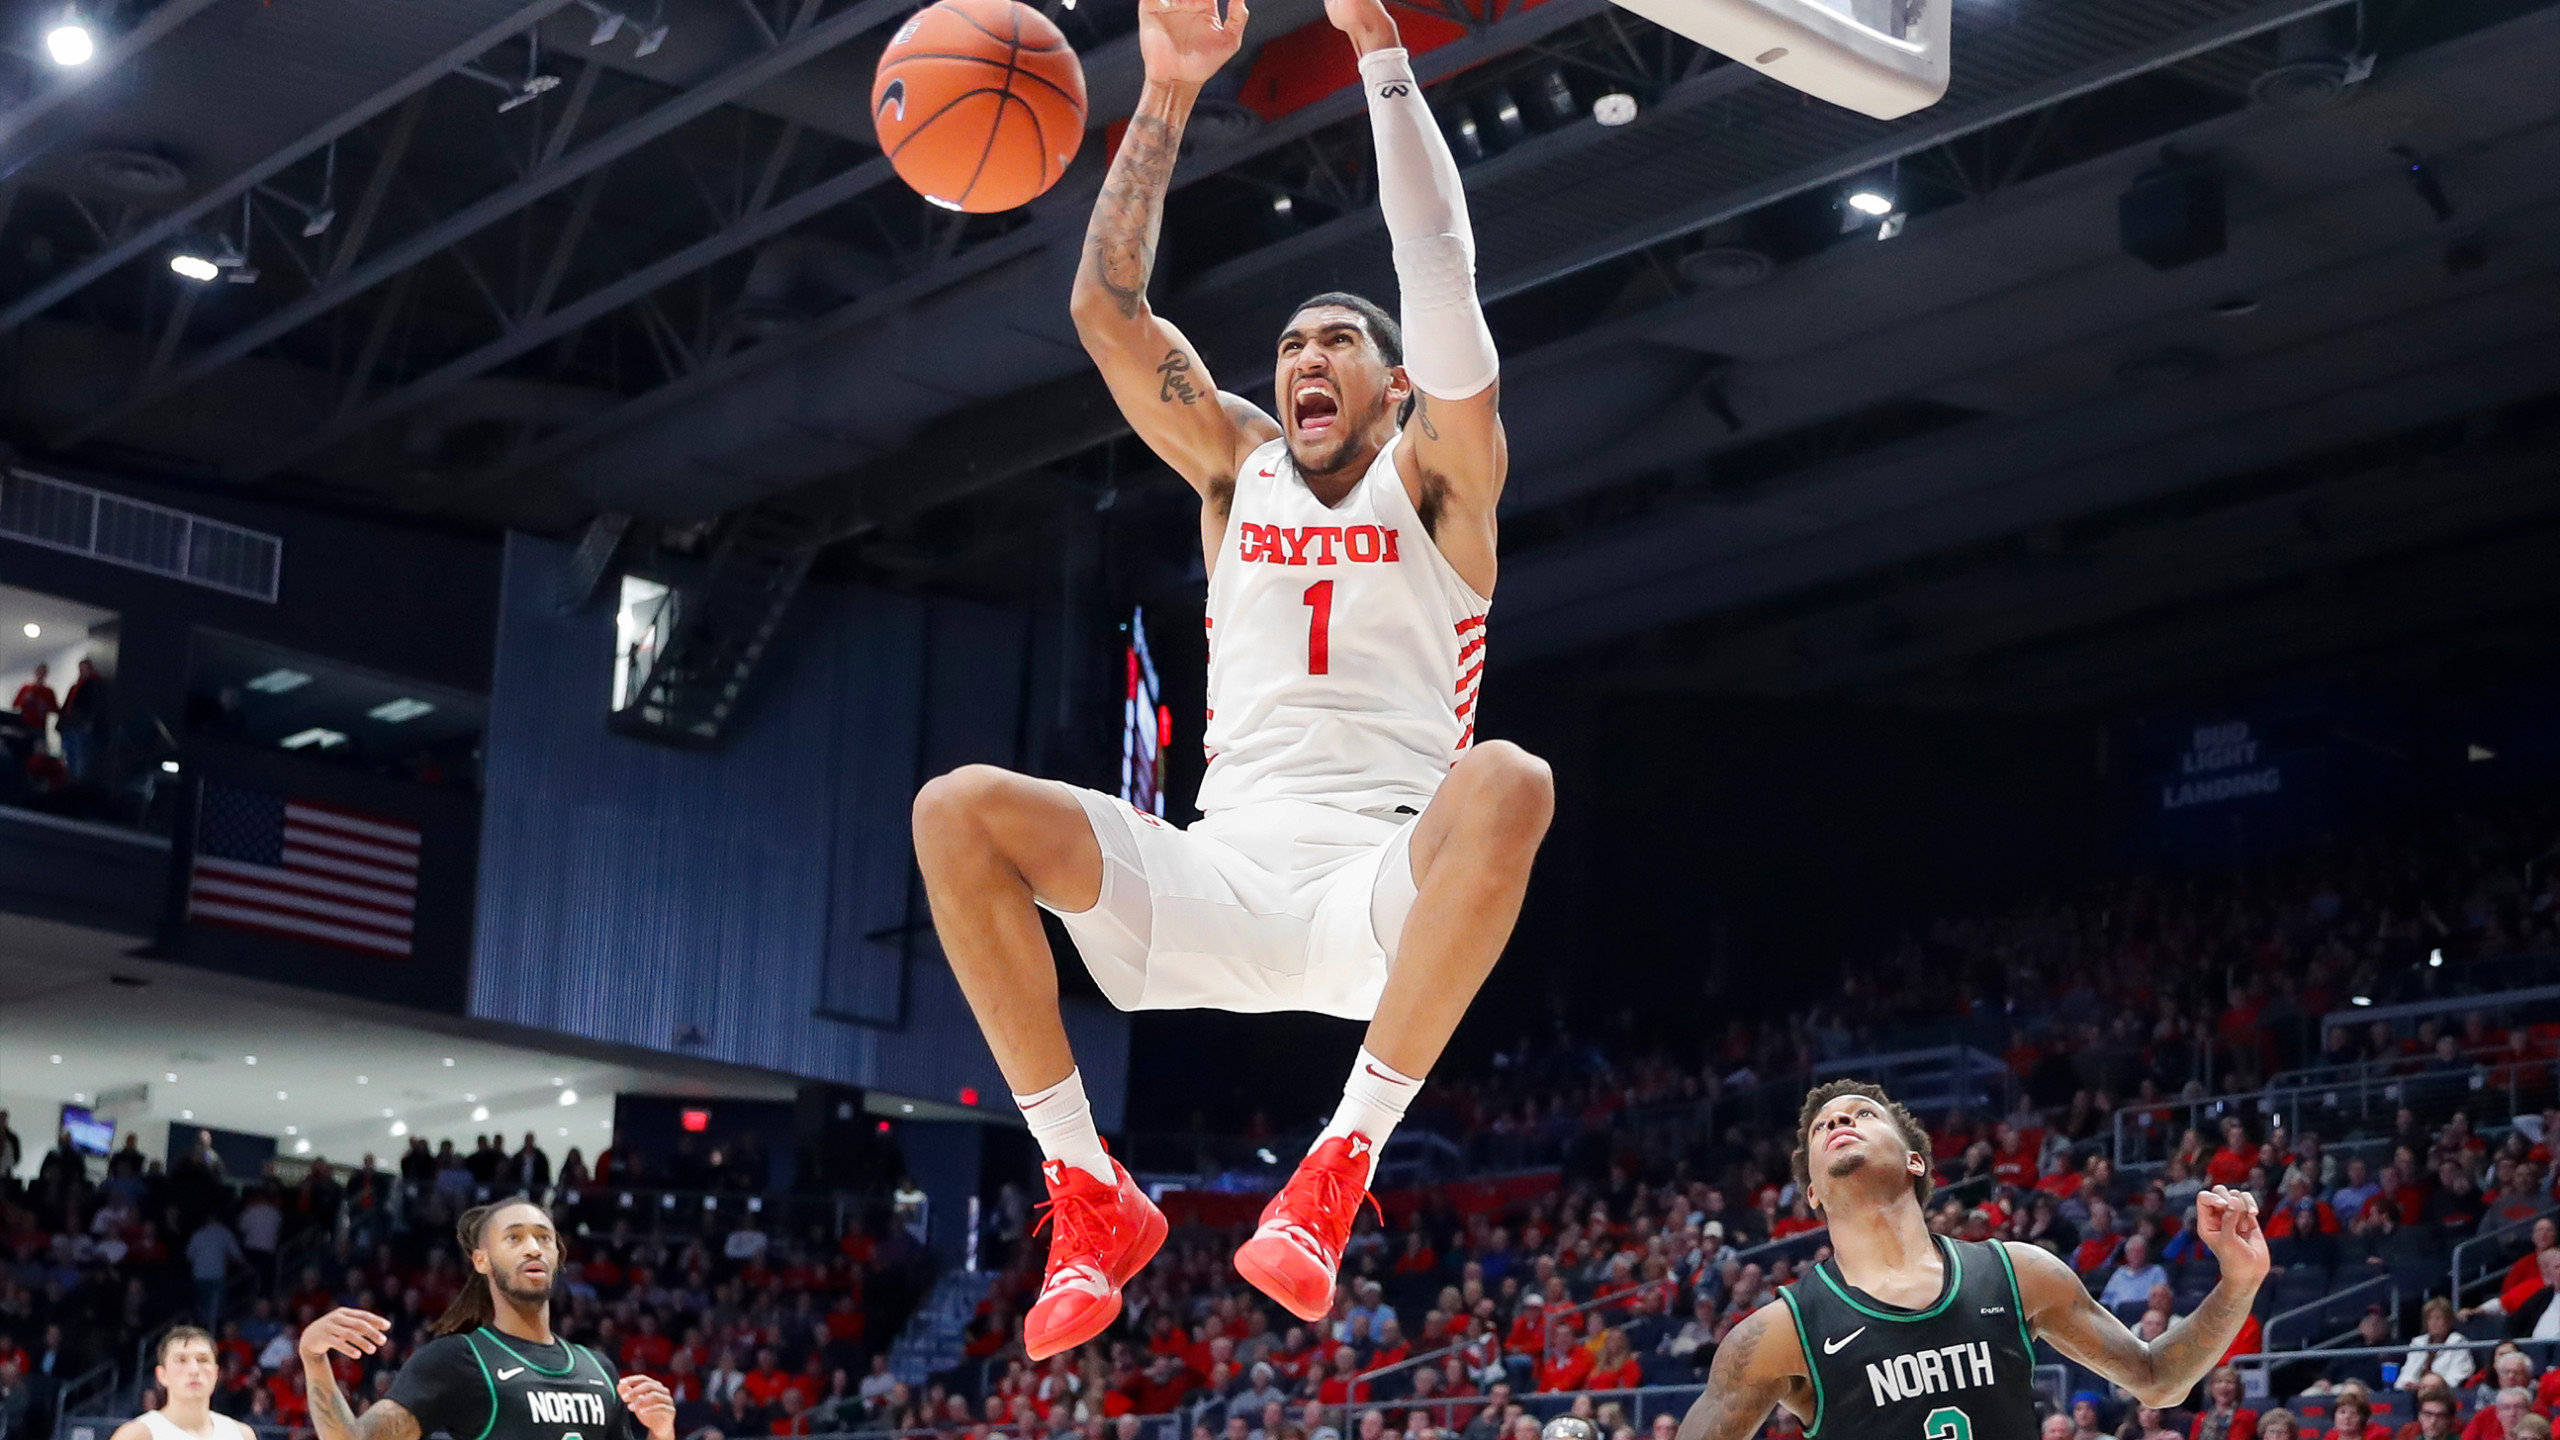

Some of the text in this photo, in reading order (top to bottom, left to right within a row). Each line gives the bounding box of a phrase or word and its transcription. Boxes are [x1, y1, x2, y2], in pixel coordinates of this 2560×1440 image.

[1303, 580, 1333, 675] 1
[2162, 767, 2281, 809] LANDING
[1866, 1341, 1995, 1407] NORTH
[526, 1391, 606, 1426] NORTH
